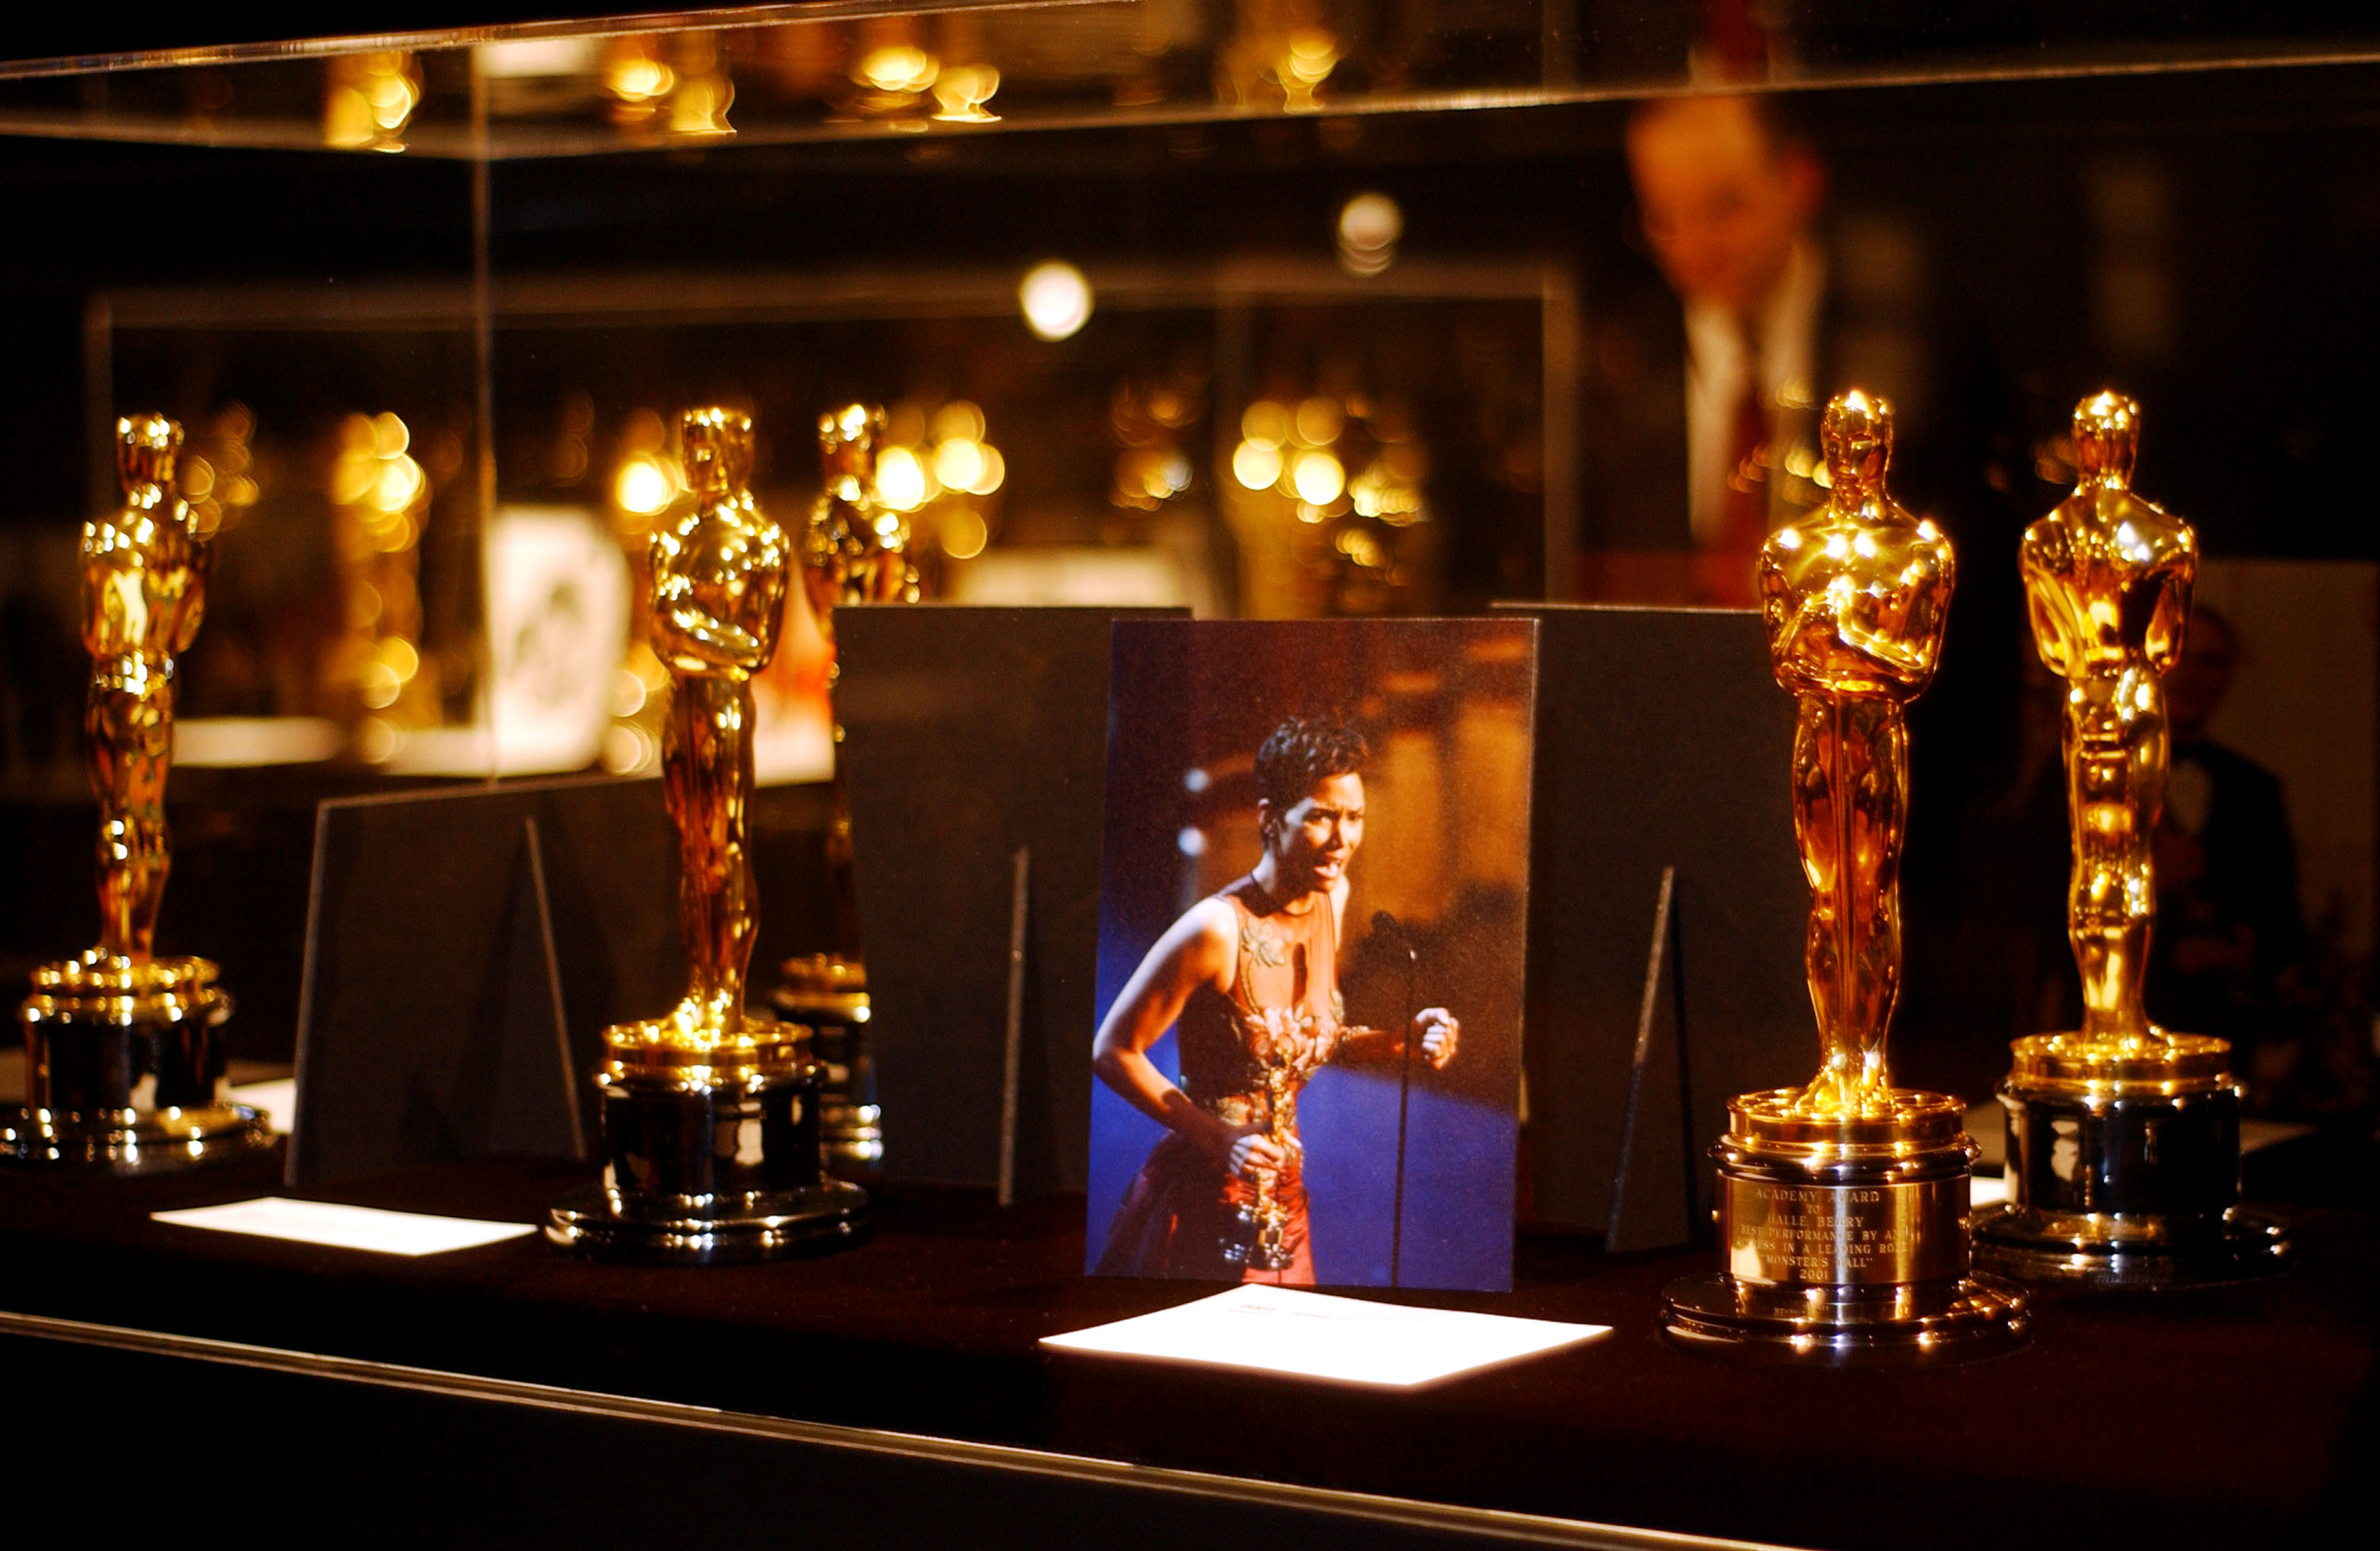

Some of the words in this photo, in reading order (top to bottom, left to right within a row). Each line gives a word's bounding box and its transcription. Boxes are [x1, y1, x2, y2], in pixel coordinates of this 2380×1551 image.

[1756, 1188, 1817, 1202] ACADEMY
[1828, 1190, 1879, 1203] AWARD
[1807, 1205, 1820, 1214] TO
[1768, 1213, 1807, 1227] HALLE
[1818, 1215, 1864, 1228] BERRY
[1741, 1224, 1762, 1236] BEST
[1862, 1230, 1878, 1241] BY
[1735, 1237, 1776, 1251] ACESS
[1783, 1242, 1795, 1253] IN
[1802, 1243, 1810, 1253] A
[1818, 1243, 1871, 1254] LEADING
[1799, 1269, 1828, 1280] 2001
